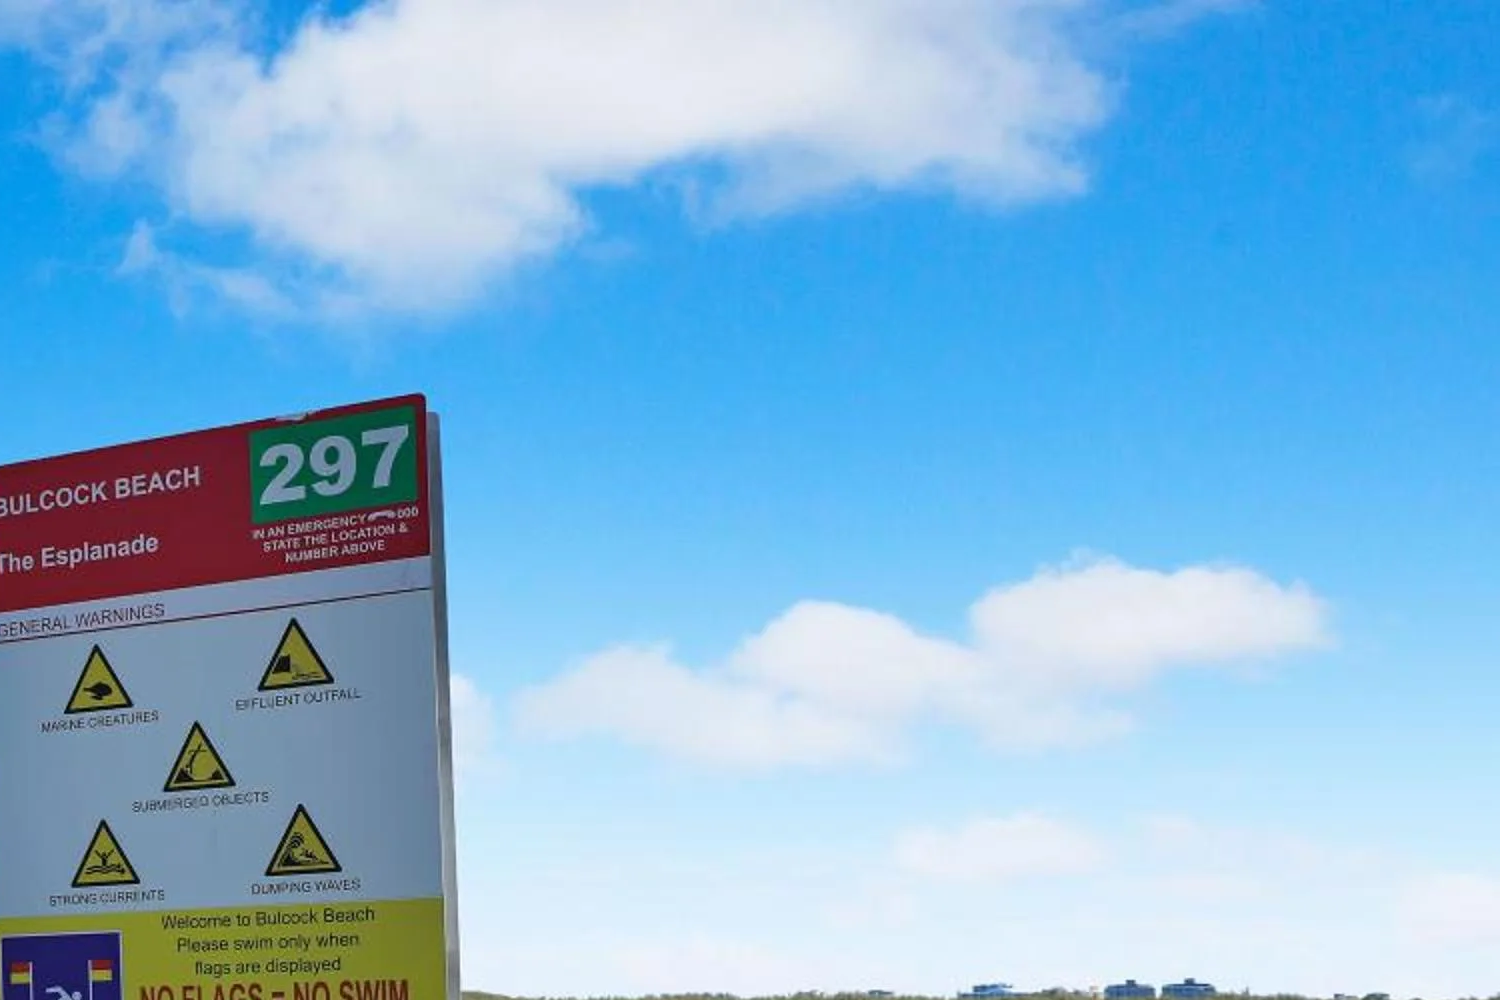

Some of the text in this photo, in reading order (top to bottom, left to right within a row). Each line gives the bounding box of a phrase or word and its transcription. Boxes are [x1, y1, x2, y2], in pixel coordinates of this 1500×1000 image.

[259, 423, 409, 505] 297
[115, 465, 200, 499] BEACH
[253, 507, 419, 540] IN AN EMERGENCY 000
[263, 522, 409, 553] STATE THE LOCATION &
[41, 533, 159, 569] Esplanade
[284, 539, 386, 564] NUMBER ABOVE
[75, 602, 166, 627] WARNINGS
[236, 688, 362, 711] EFFLUENT OUTFALL
[41, 709, 160, 733] MARINE CREATURES
[132, 791, 270, 813] SUBMERGED OBJECTS
[49, 889, 165, 908] STRONG CURRENTS
[251, 878, 362, 896] DUMPING WAVES
[162, 905, 376, 930] Welcome to Bulcock Beach
[177, 932, 361, 953] Please swim only when
[195, 957, 342, 979] flags are displayed
